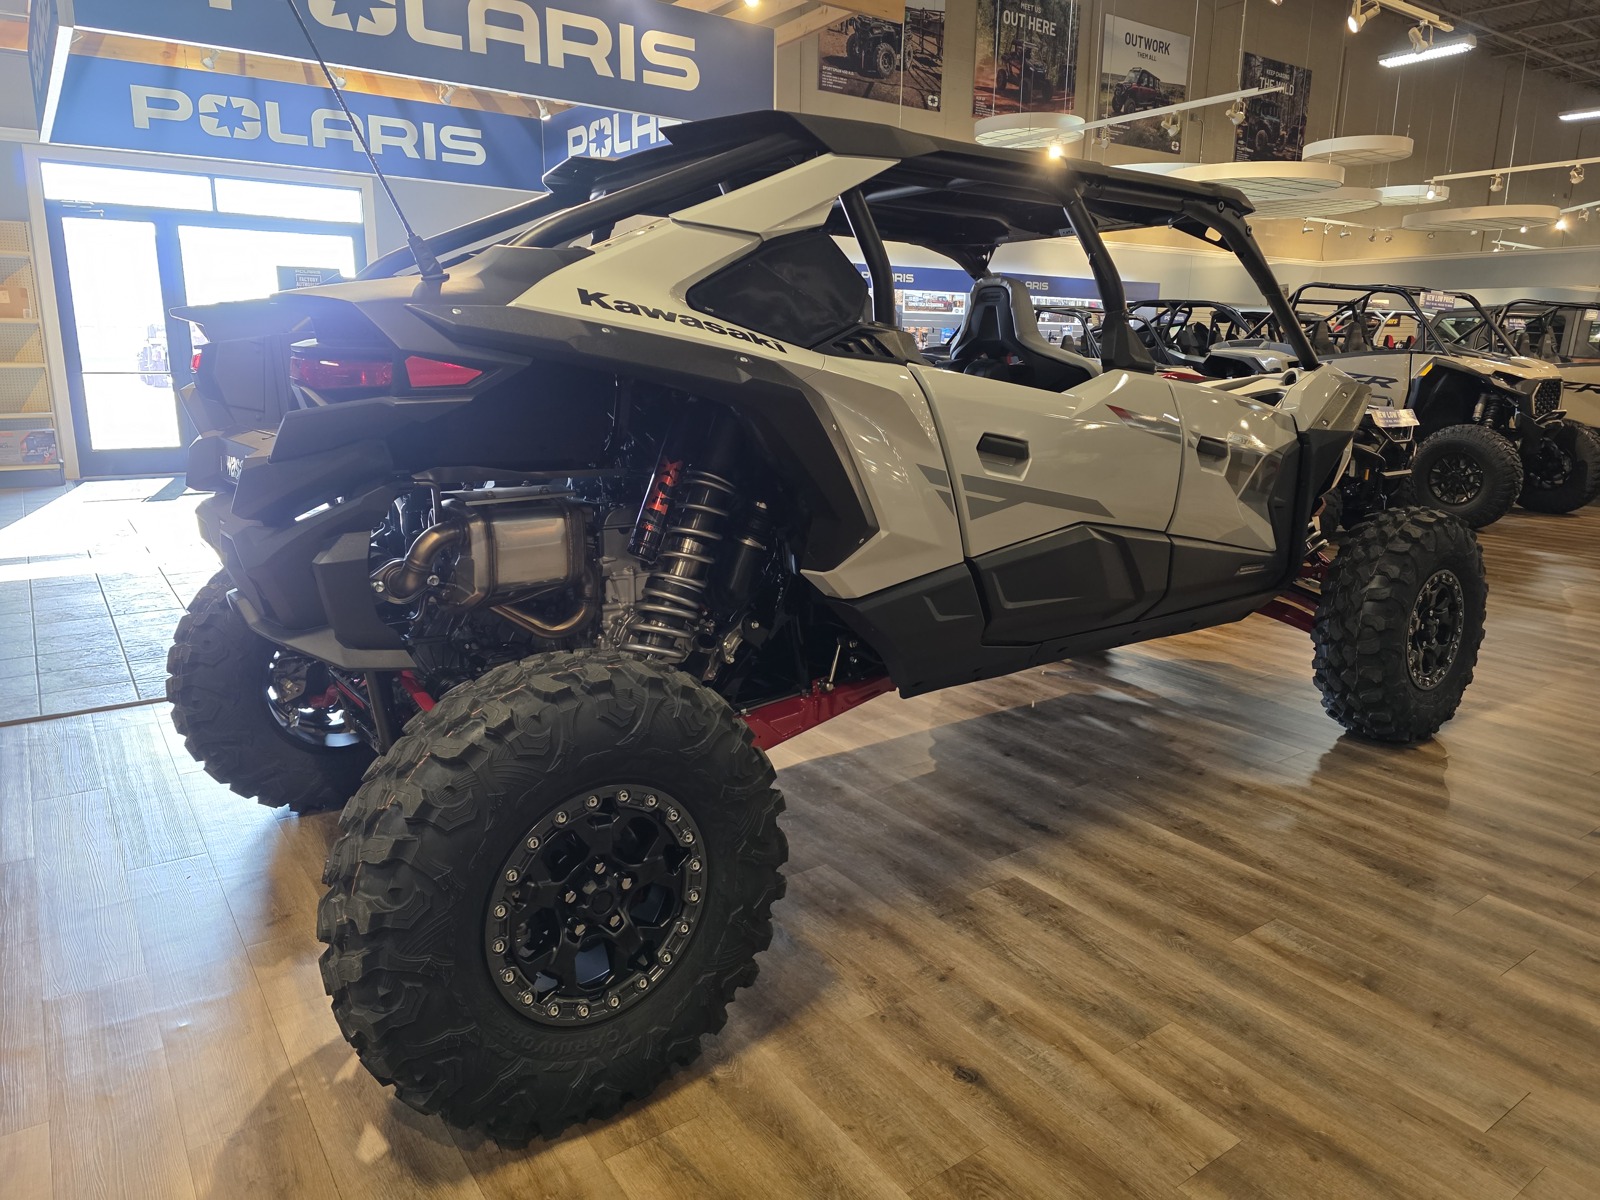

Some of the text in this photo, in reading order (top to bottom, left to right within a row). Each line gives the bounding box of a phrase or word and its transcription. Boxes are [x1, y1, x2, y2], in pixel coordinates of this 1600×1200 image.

[1021, 2, 1034, 11] MEET
[1003, 9, 1057, 37] OUT HERE
[208, 0, 701, 92] OLARIS
[1124, 31, 1171, 56] OUTWORK
[1137, 51, 1149, 59] THEM
[1259, 76, 1275, 90] THE
[130, 84, 486, 166] POLARIS
[577, 287, 788, 354] Kawasaki
